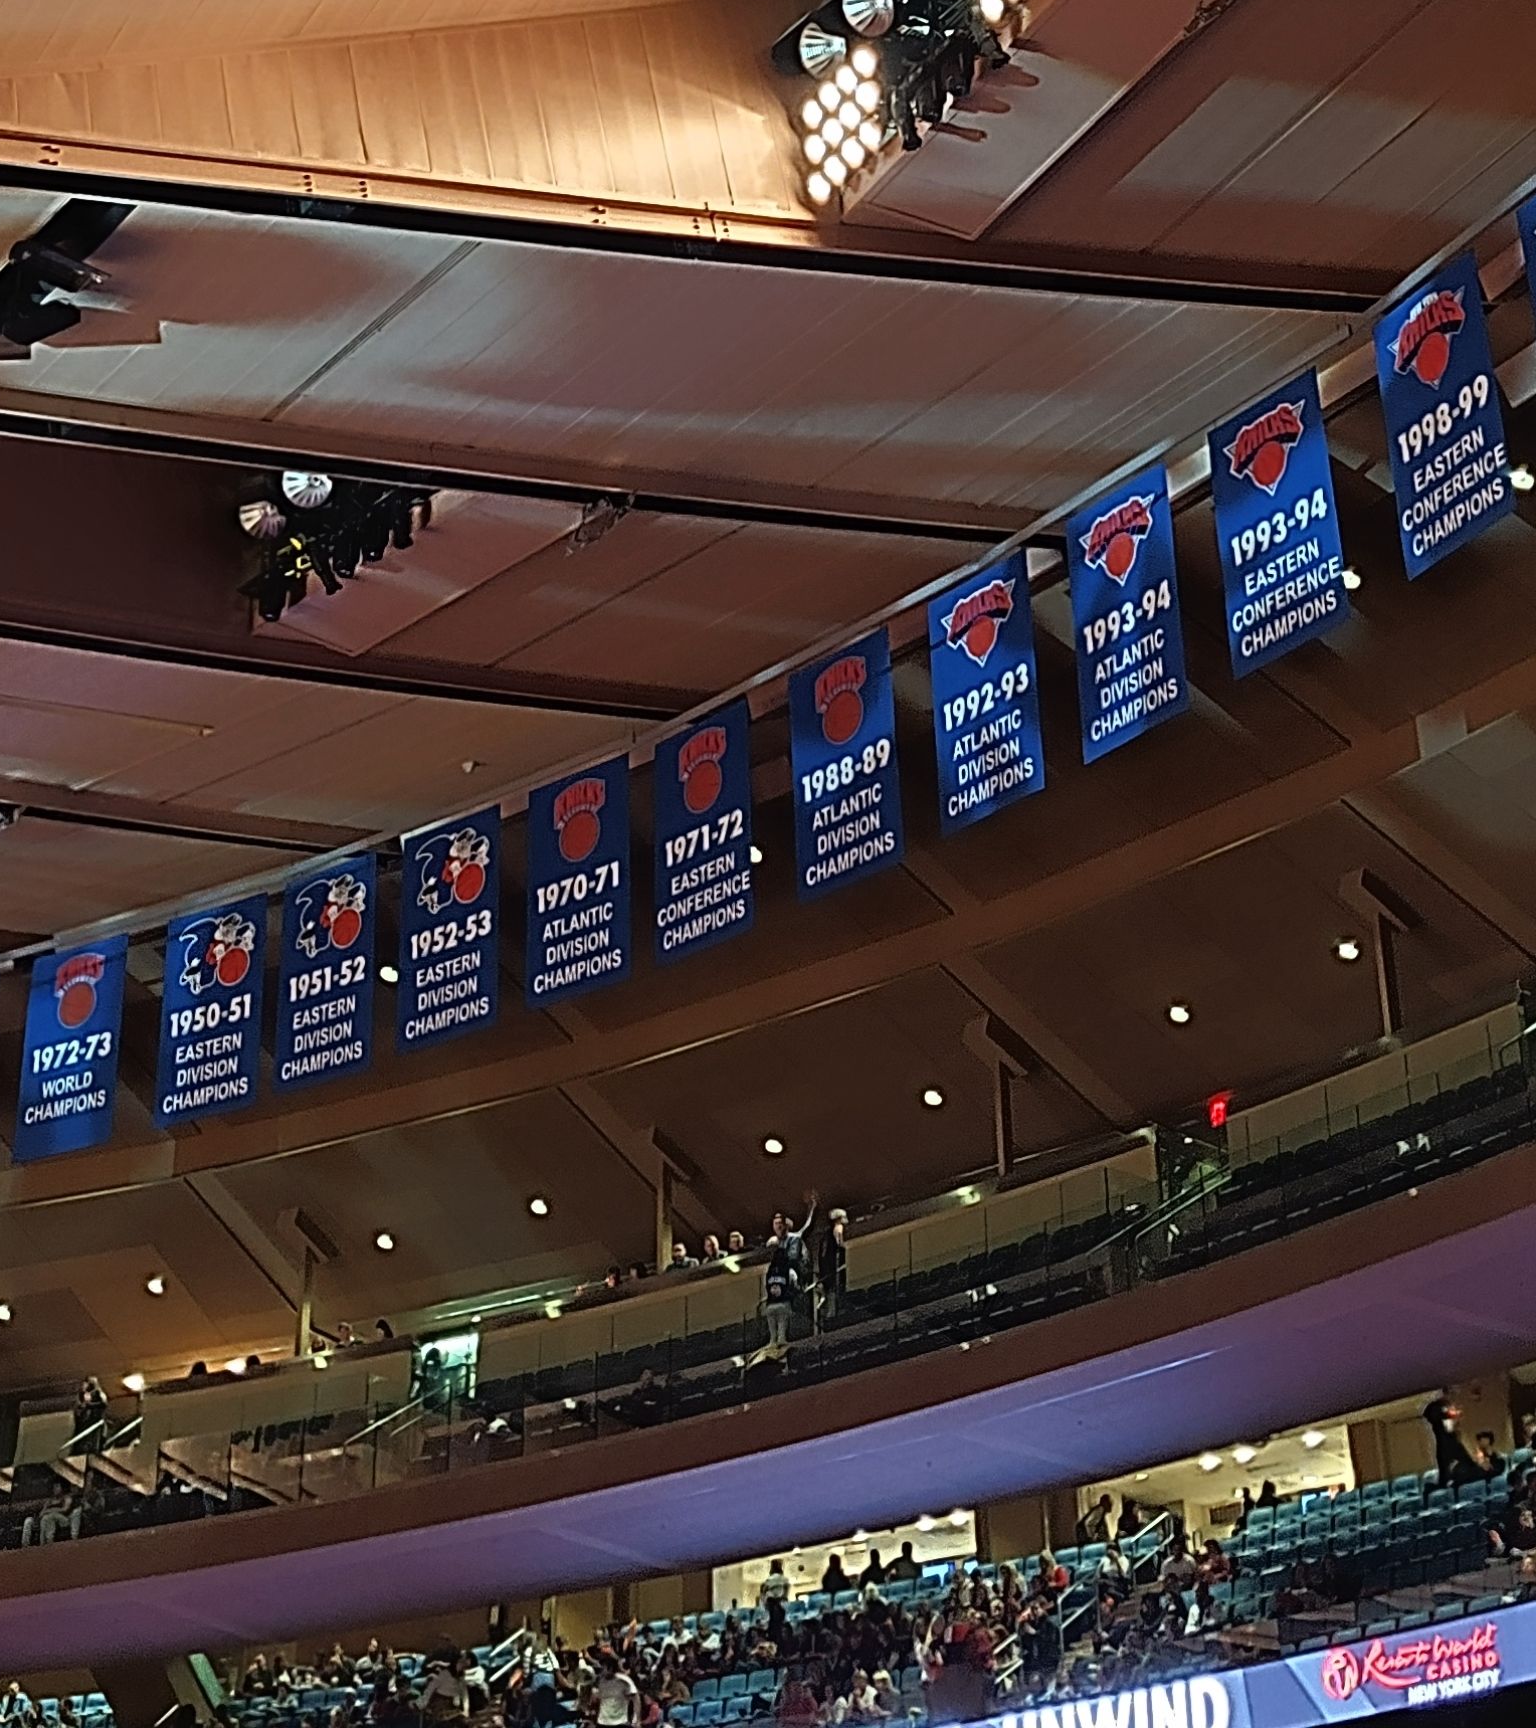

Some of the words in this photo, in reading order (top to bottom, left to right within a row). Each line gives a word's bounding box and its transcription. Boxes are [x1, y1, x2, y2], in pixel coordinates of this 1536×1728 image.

[1395, 289, 1466, 370] KNICKS
[1398, 374, 1489, 463] 1998-99
[1414, 426, 1485, 493] EASTERN
[1402, 443, 1507, 531] CONFERENCE
[1231, 488, 1327, 566] 1993-94
[1413, 477, 1505, 556] CHAMPIONS
[1245, 538, 1319, 597] EASTERN
[1083, 579, 1172, 655] 1993-94
[1232, 556, 1340, 633] CONFERENCE
[1240, 589, 1338, 657] CHAMPIONS
[1094, 628, 1165, 684] ATLANTIC
[944, 663, 1029, 732] 1992-93
[1101, 656, 1163, 710] DIVISION
[953, 708, 1022, 761] ATLANTIC
[1090, 678, 1178, 742] CHAMPIONS
[802, 738, 890, 803] 1988-89
[958, 736, 1020, 785] DIVISION
[812, 782, 882, 832] ATLANTIC
[948, 757, 1034, 816] CHAMPIONS
[665, 808, 744, 867] 1971-72
[817, 809, 880, 855] DIVISION
[671, 852, 735, 896] EASTERN
[805, 832, 895, 887] CHAMPIONS
[536, 861, 620, 914] 1970-71
[657, 870, 751, 927] CONFERENCE
[411, 910, 492, 960] 1952-53
[543, 902, 613, 942] ATLANTIC
[546, 928, 610, 965] DIVISION
[663, 898, 746, 950] CHAMPIONS
[289, 956, 366, 1002] 1951-52
[416, 950, 481, 987] EASTERN
[417, 975, 478, 1012] DIVISION
[534, 948, 622, 994] CHAMPIONS
[170, 993, 252, 1038] 1950-51
[292, 995, 356, 1031] EASTERN
[293, 1020, 352, 1053] DIVISION
[405, 997, 490, 1040] CHAMPIONS
[32, 1032, 112, 1073] 1972-73
[175, 1032, 242, 1064] EASTERN
[176, 1057, 238, 1087] DIVISION
[281, 1040, 363, 1080] CHAMPIONS
[24, 1090, 106, 1124] CHAMPIONS
[42, 1071, 93, 1098] WORLD
[162, 1077, 248, 1114] CHAMPIONS
[1362, 1639, 1431, 1690] Resorts
[1433, 1622, 1497, 1661] World
[1426, 1651, 1500, 1681] CASINO
[1408, 1682, 1437, 1705] NEW
[1439, 1676, 1472, 1699] YORK
[1472, 1669, 1500, 1693] CITY
